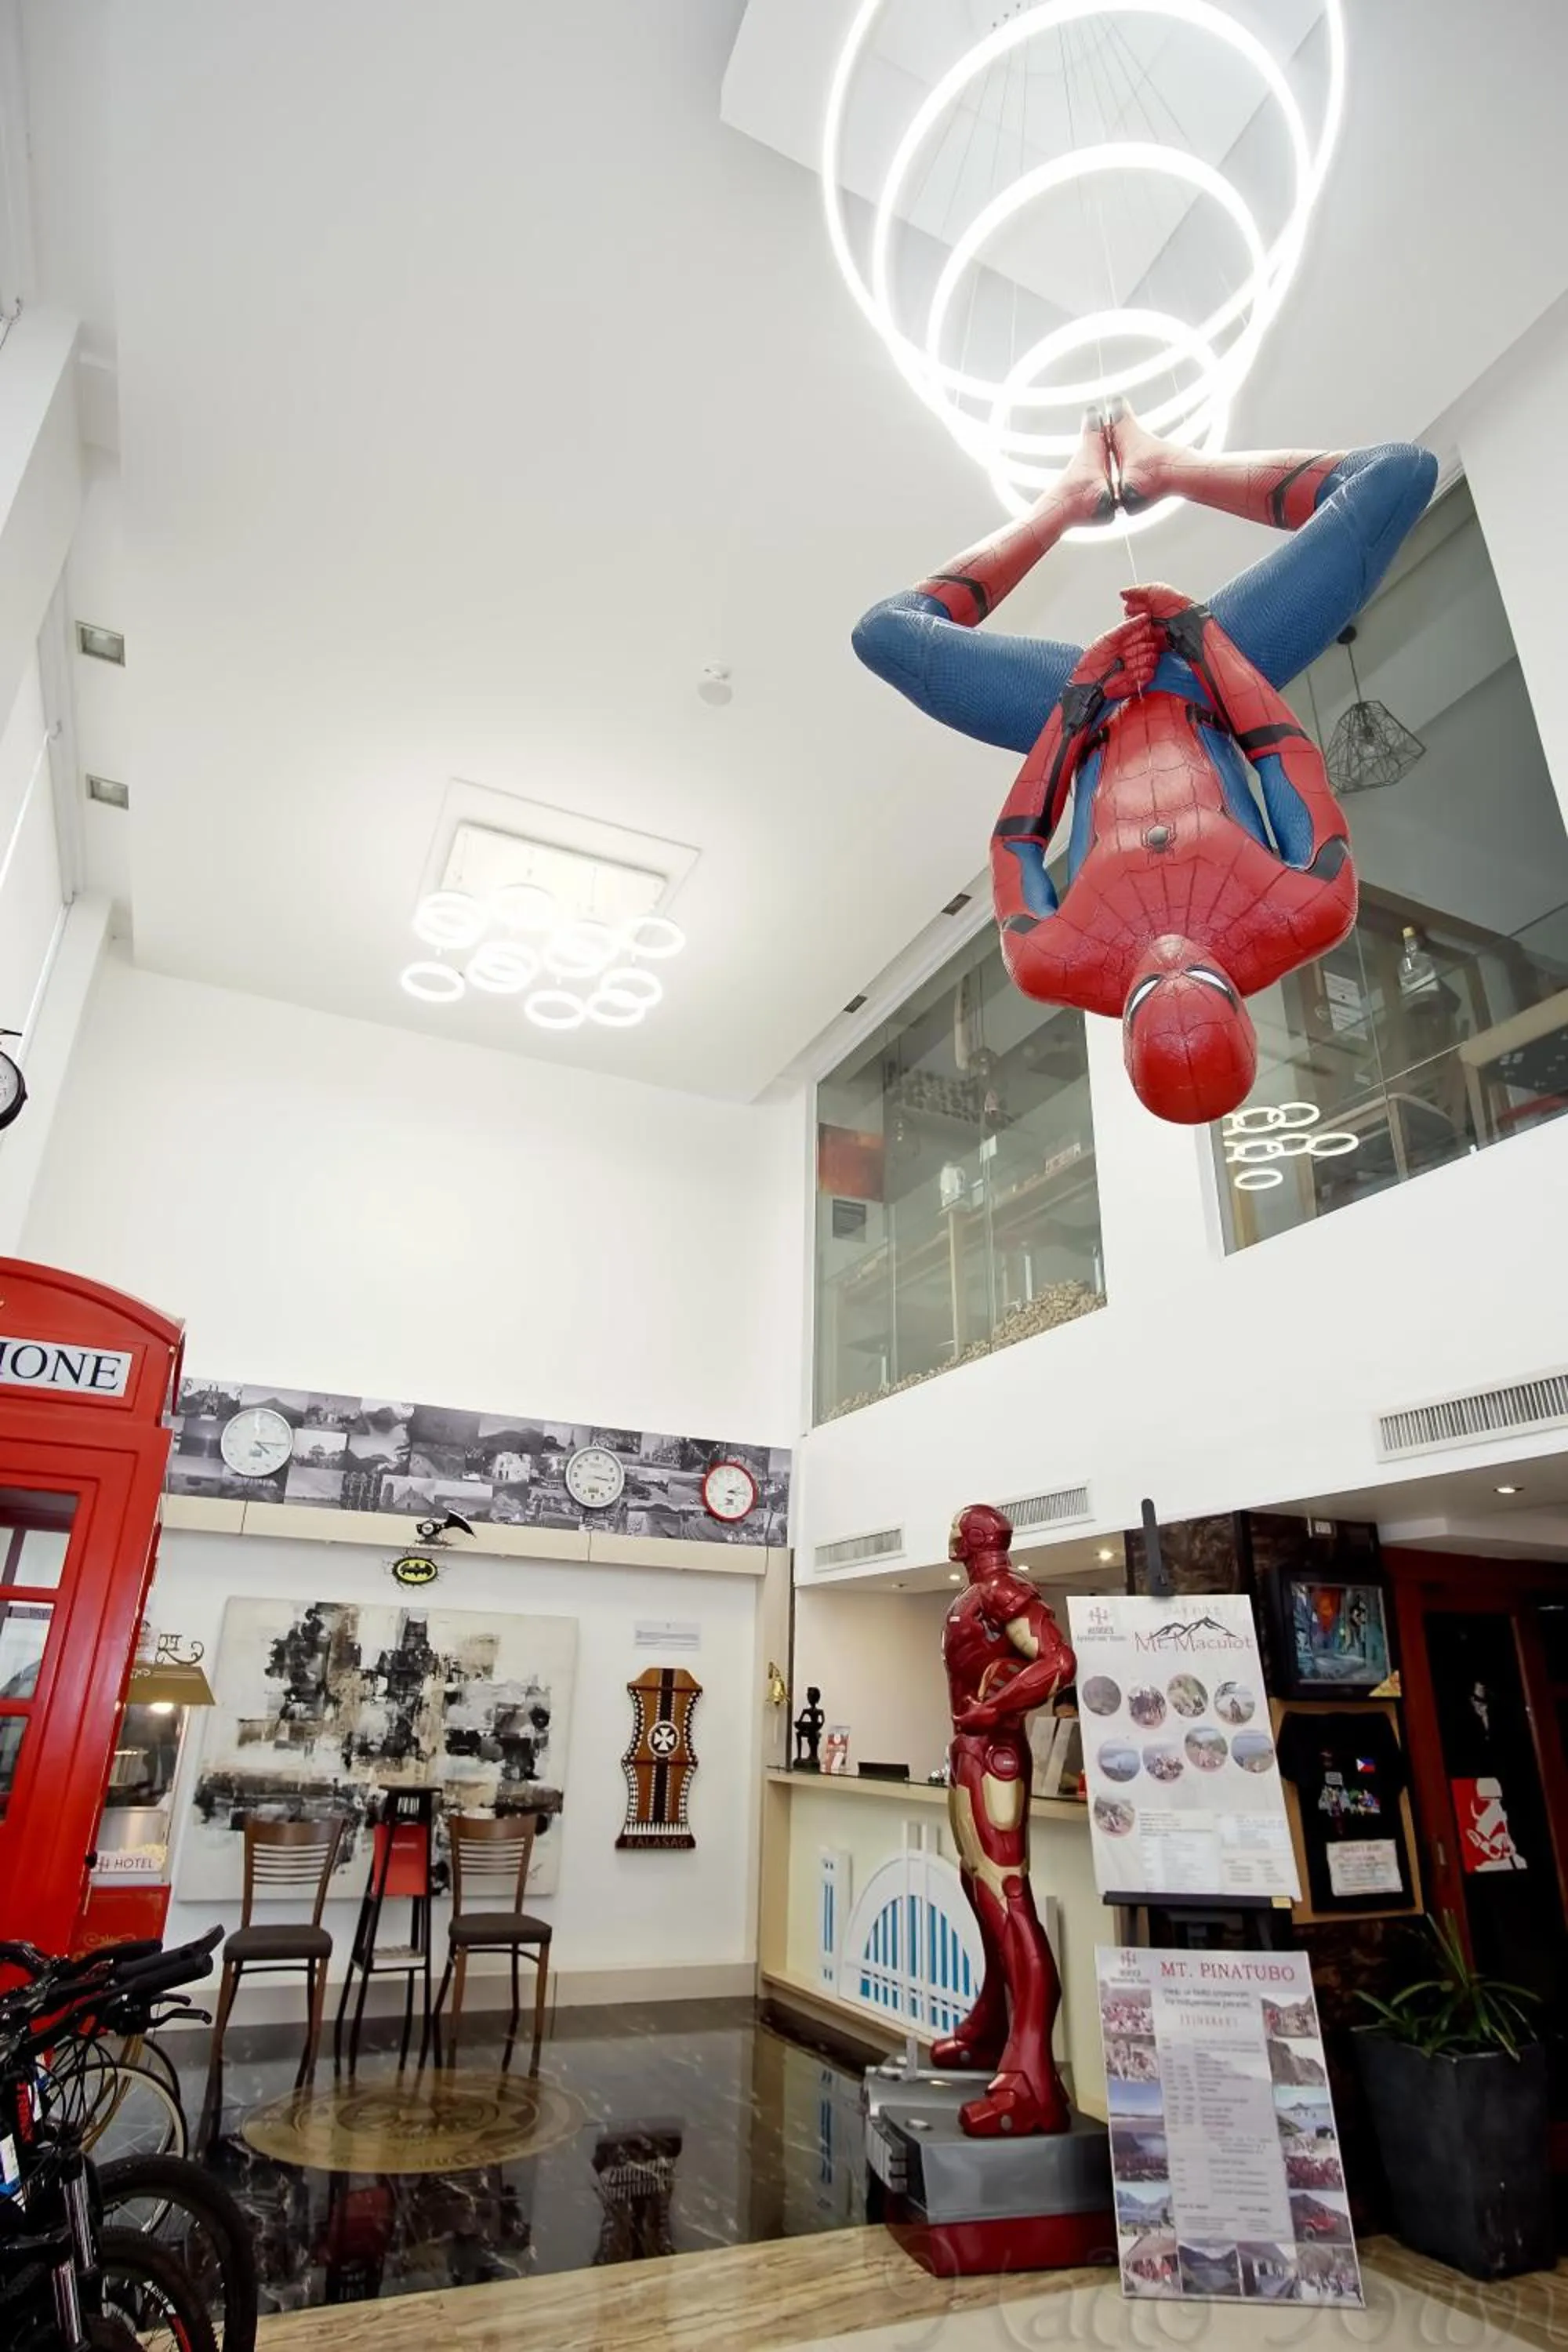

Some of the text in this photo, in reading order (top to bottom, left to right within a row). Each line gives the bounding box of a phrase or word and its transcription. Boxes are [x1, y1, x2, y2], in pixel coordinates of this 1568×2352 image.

[626, 1837, 688, 1849] KALASAG
[114, 1857, 154, 1869] HOTEL
[1160, 1961, 1193, 1978] MT.
[1200, 1962, 1295, 1982] PINATUBO
